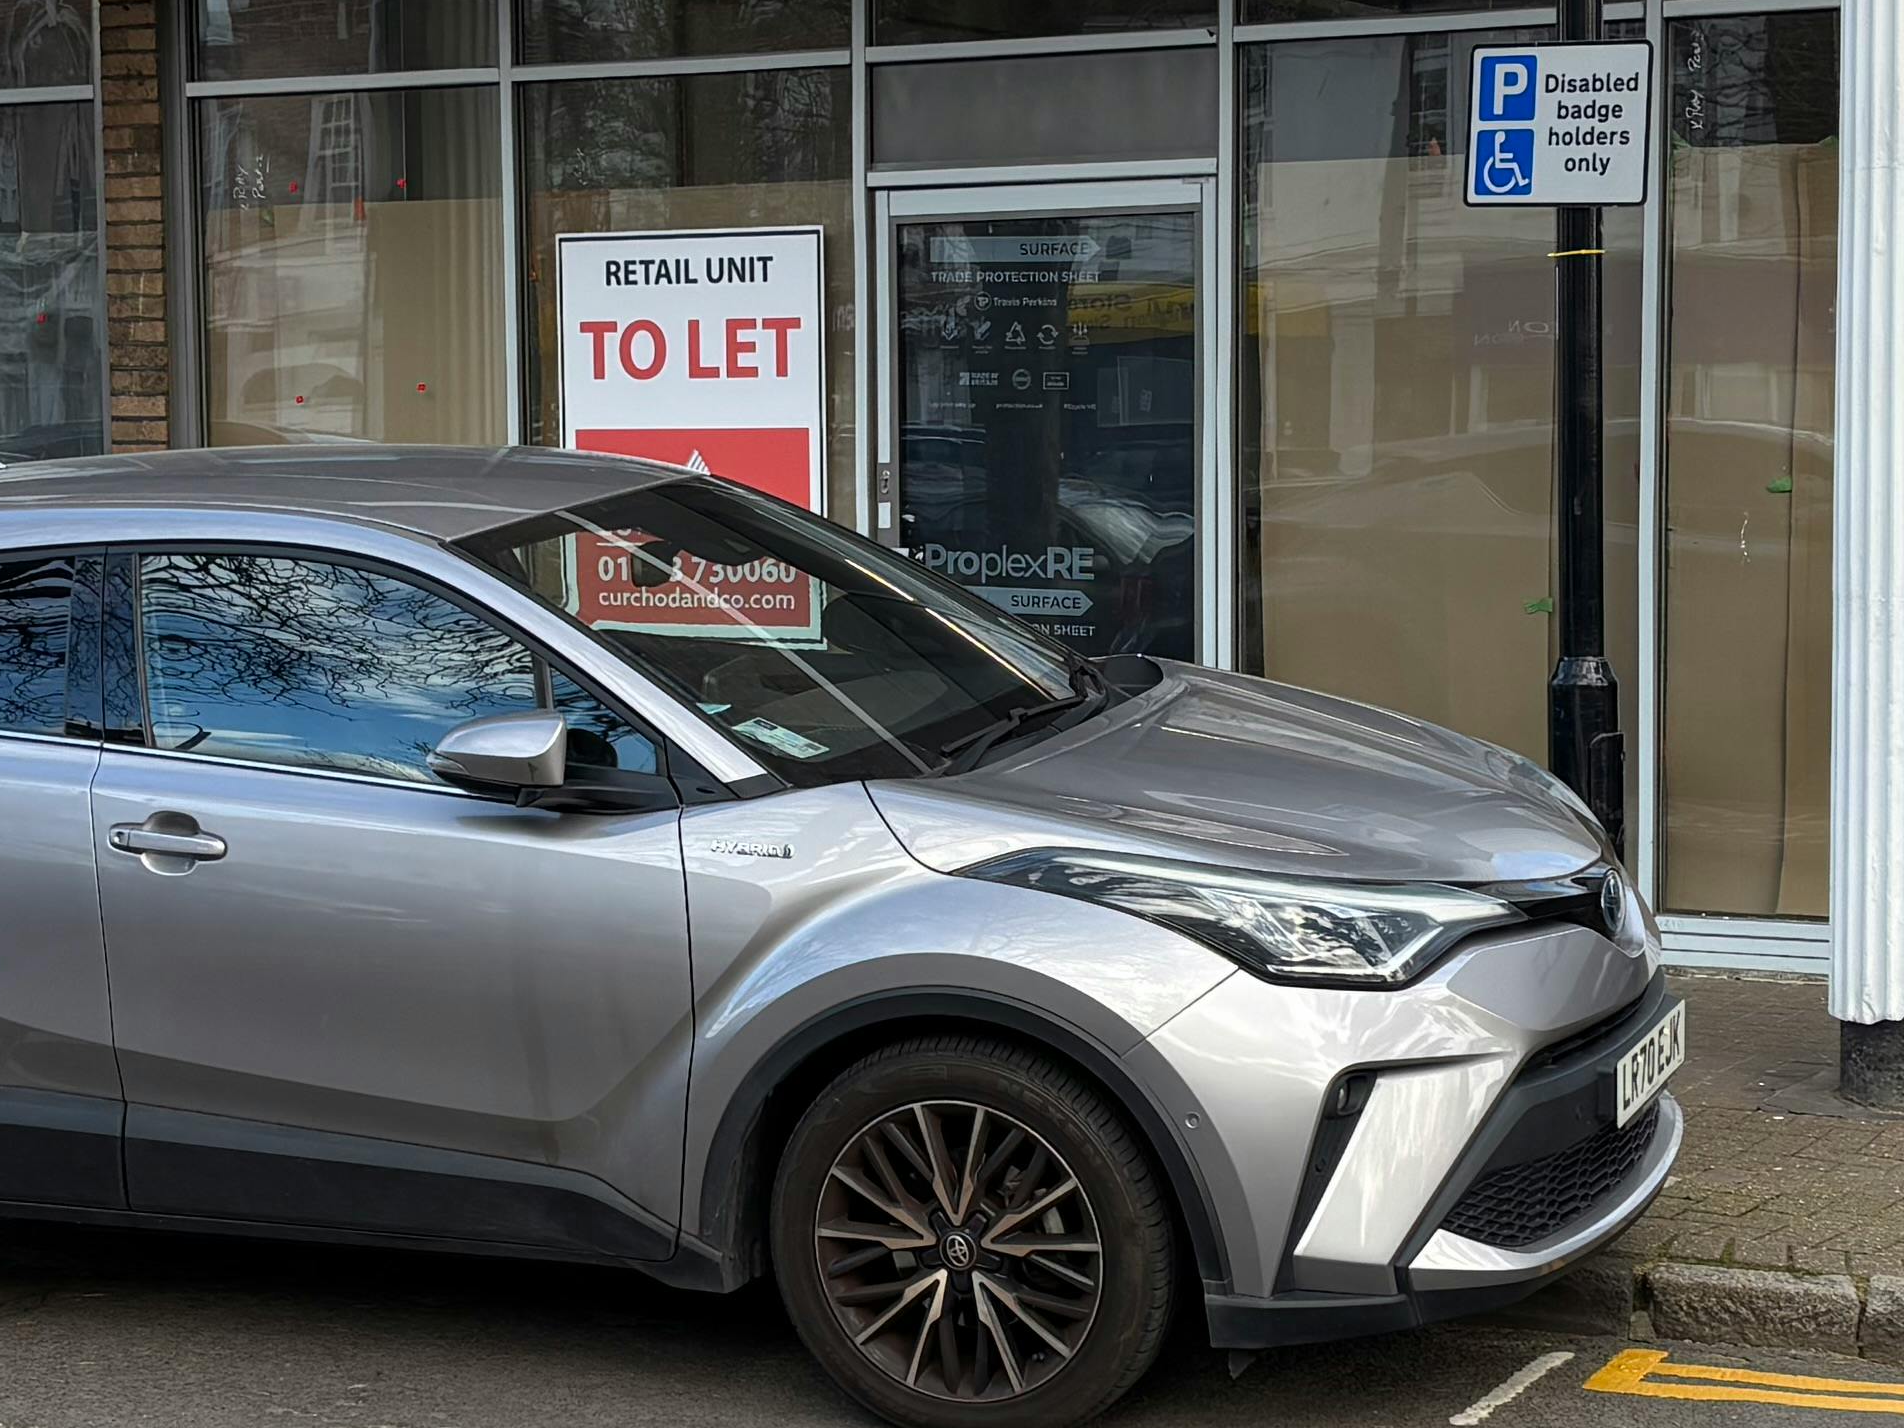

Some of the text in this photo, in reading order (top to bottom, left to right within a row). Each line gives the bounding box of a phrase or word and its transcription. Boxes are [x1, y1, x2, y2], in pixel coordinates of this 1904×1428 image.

[1493, 63, 1528, 115] P
[1545, 72, 1639, 94] Disabled
[1557, 101, 1624, 123] badge
[1548, 127, 1630, 146] holders
[1564, 153, 1611, 176] only
[1020, 243, 1089, 256] SURFACE
[604, 256, 774, 287] RETAIL UNIT
[931, 272, 1100, 283] TRADE PROTECTION SHEET
[580, 319, 667, 380] TO
[687, 316, 802, 379] LET
[598, 556, 683, 583] 013
[925, 543, 1095, 584] ProplexRE
[599, 587, 796, 610] curchodandco.com
[1011, 595, 1082, 609] SURFACE
[1054, 624, 1096, 637] SHEET
[711, 839, 794, 858] HYBRID
[1623, 1011, 1680, 1111] LR70 EJK
